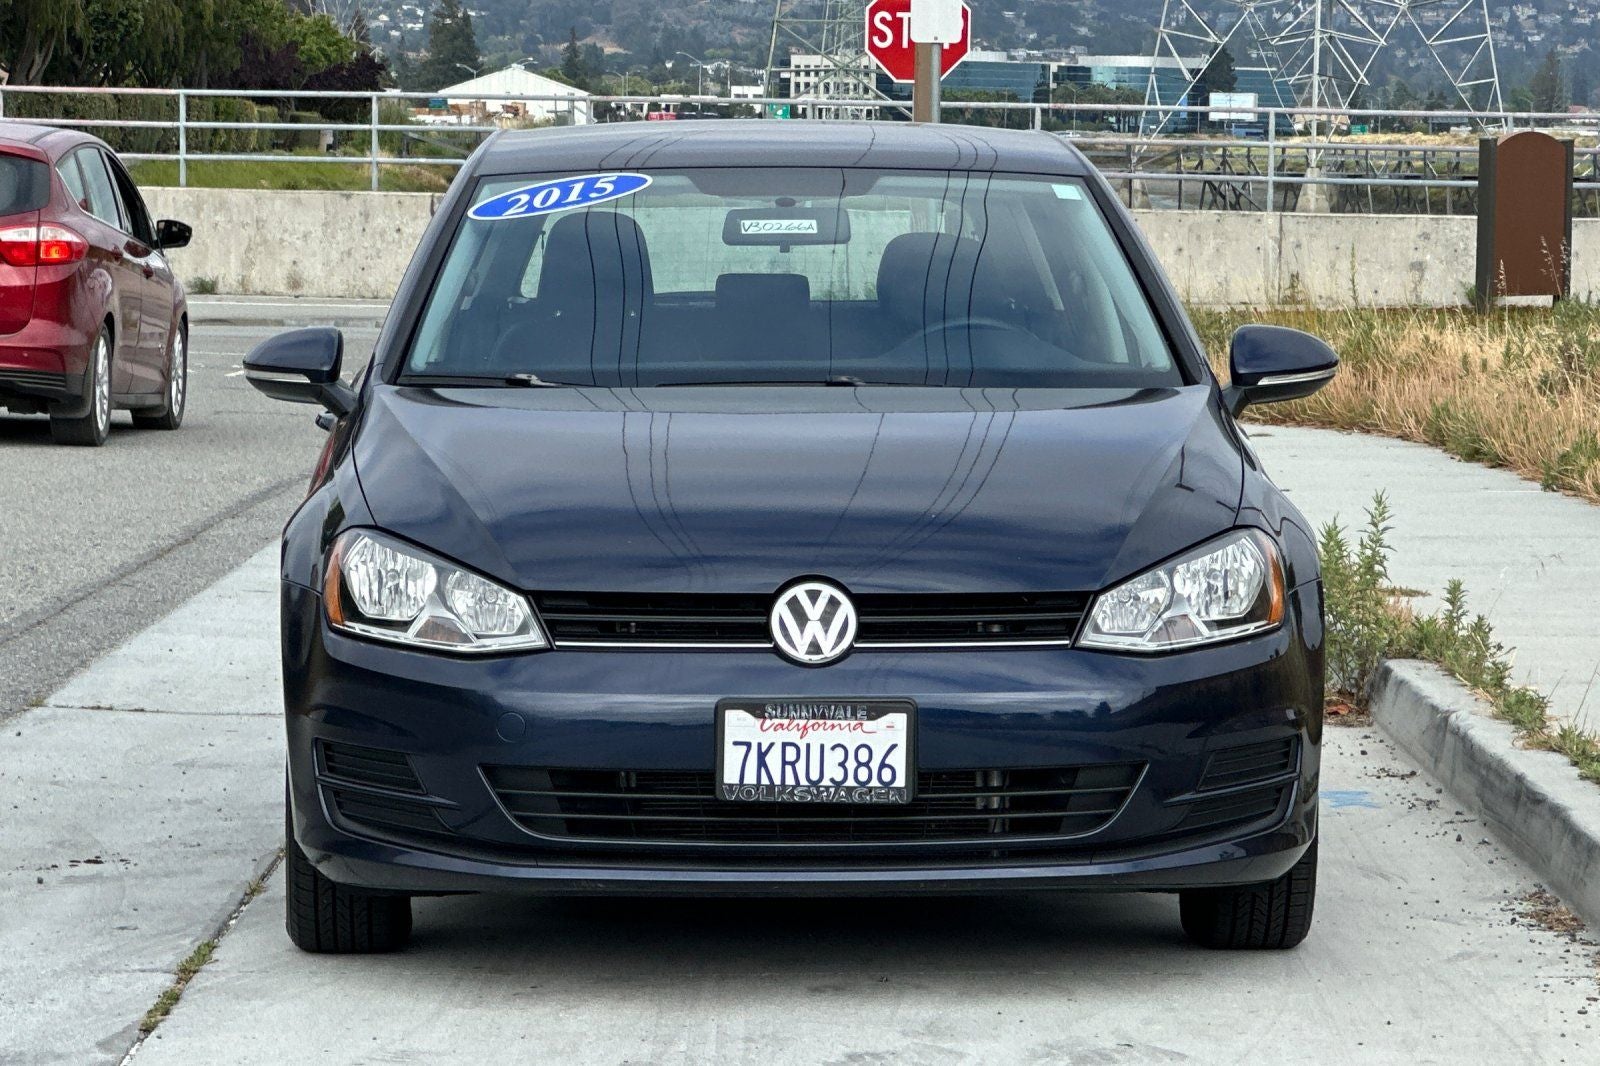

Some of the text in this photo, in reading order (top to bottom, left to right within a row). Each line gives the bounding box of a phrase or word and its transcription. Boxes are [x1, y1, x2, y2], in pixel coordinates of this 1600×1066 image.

[872, 11, 965, 49] ST
[502, 176, 618, 216] 2015
[772, 583, 856, 662] VW
[759, 718, 877, 739] California
[764, 703, 867, 721] SUNNYVALE
[732, 741, 898, 787] 7KRU386
[722, 785, 907, 804] VOLKSWAGEN
